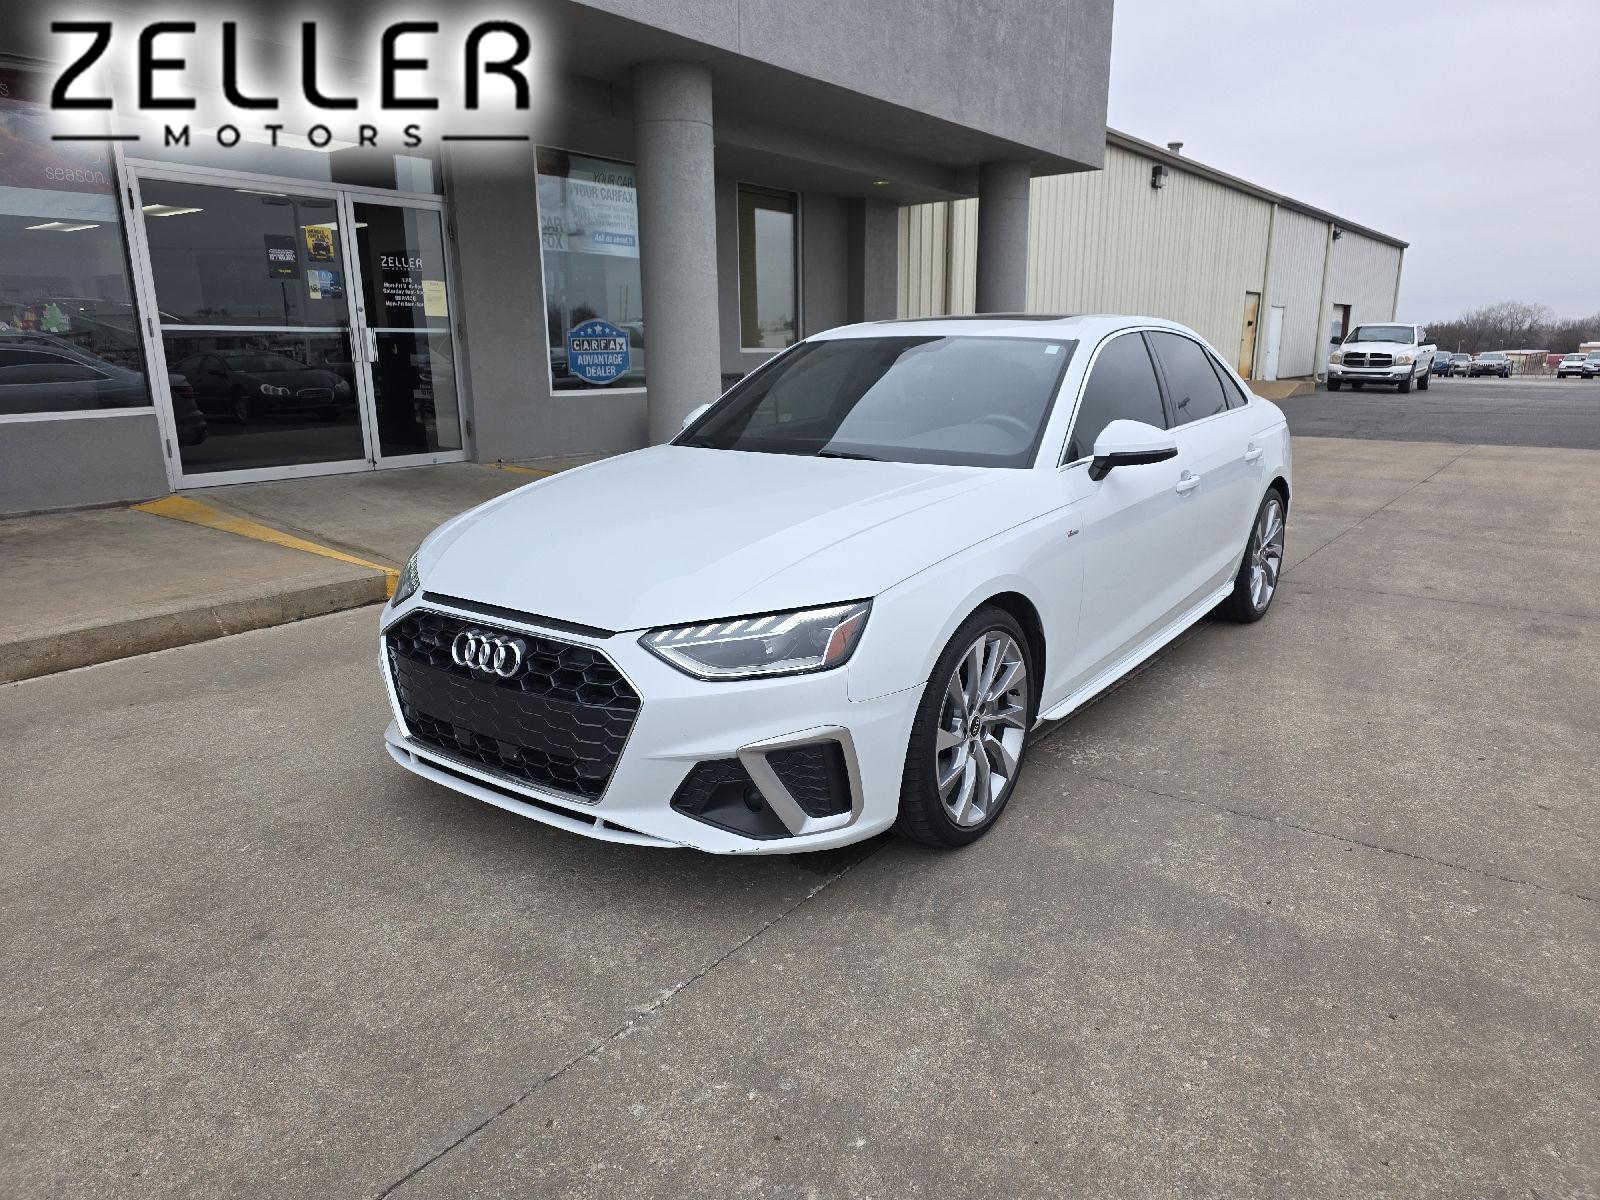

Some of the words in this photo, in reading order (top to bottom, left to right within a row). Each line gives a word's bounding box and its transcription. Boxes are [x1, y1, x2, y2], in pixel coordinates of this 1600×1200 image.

[45, 166, 109, 184] season.
[593, 170, 615, 186] YOUR
[617, 174, 633, 188] CAR
[574, 184, 598, 198] YOUR
[600, 187, 634, 203] CARFAX
[380, 255, 422, 268] ZELLER
[572, 339, 625, 351] CARFAX
[578, 353, 622, 364] ADVANTAGE
[586, 366, 616, 376] DEALER
